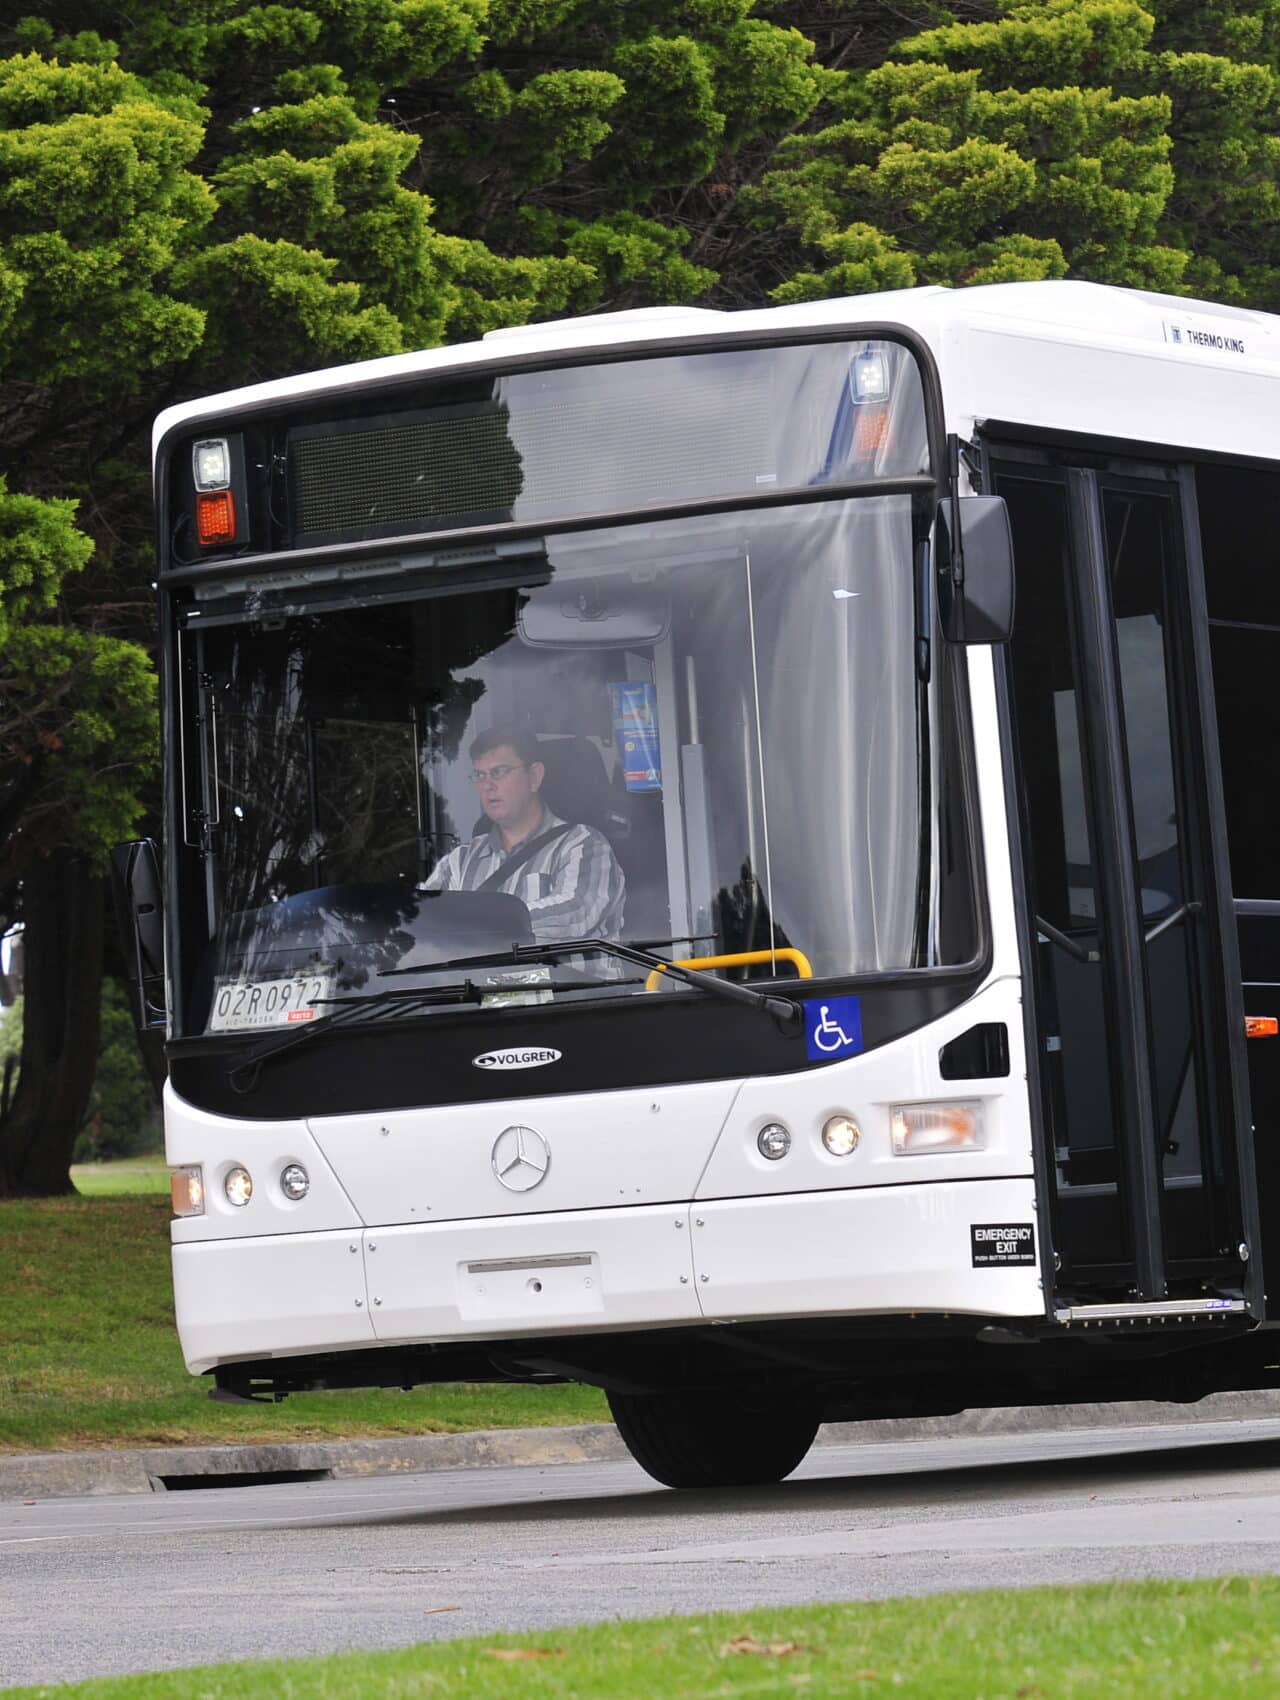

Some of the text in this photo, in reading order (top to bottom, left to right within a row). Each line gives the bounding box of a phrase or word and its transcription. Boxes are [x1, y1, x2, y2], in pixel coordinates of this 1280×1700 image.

[1187, 330, 1244, 353] THERMO KING
[497, 1050, 556, 1065] VOLGREN
[975, 1228, 1032, 1241] EMERGENCY
[996, 1241, 1018, 1254] EXIT
